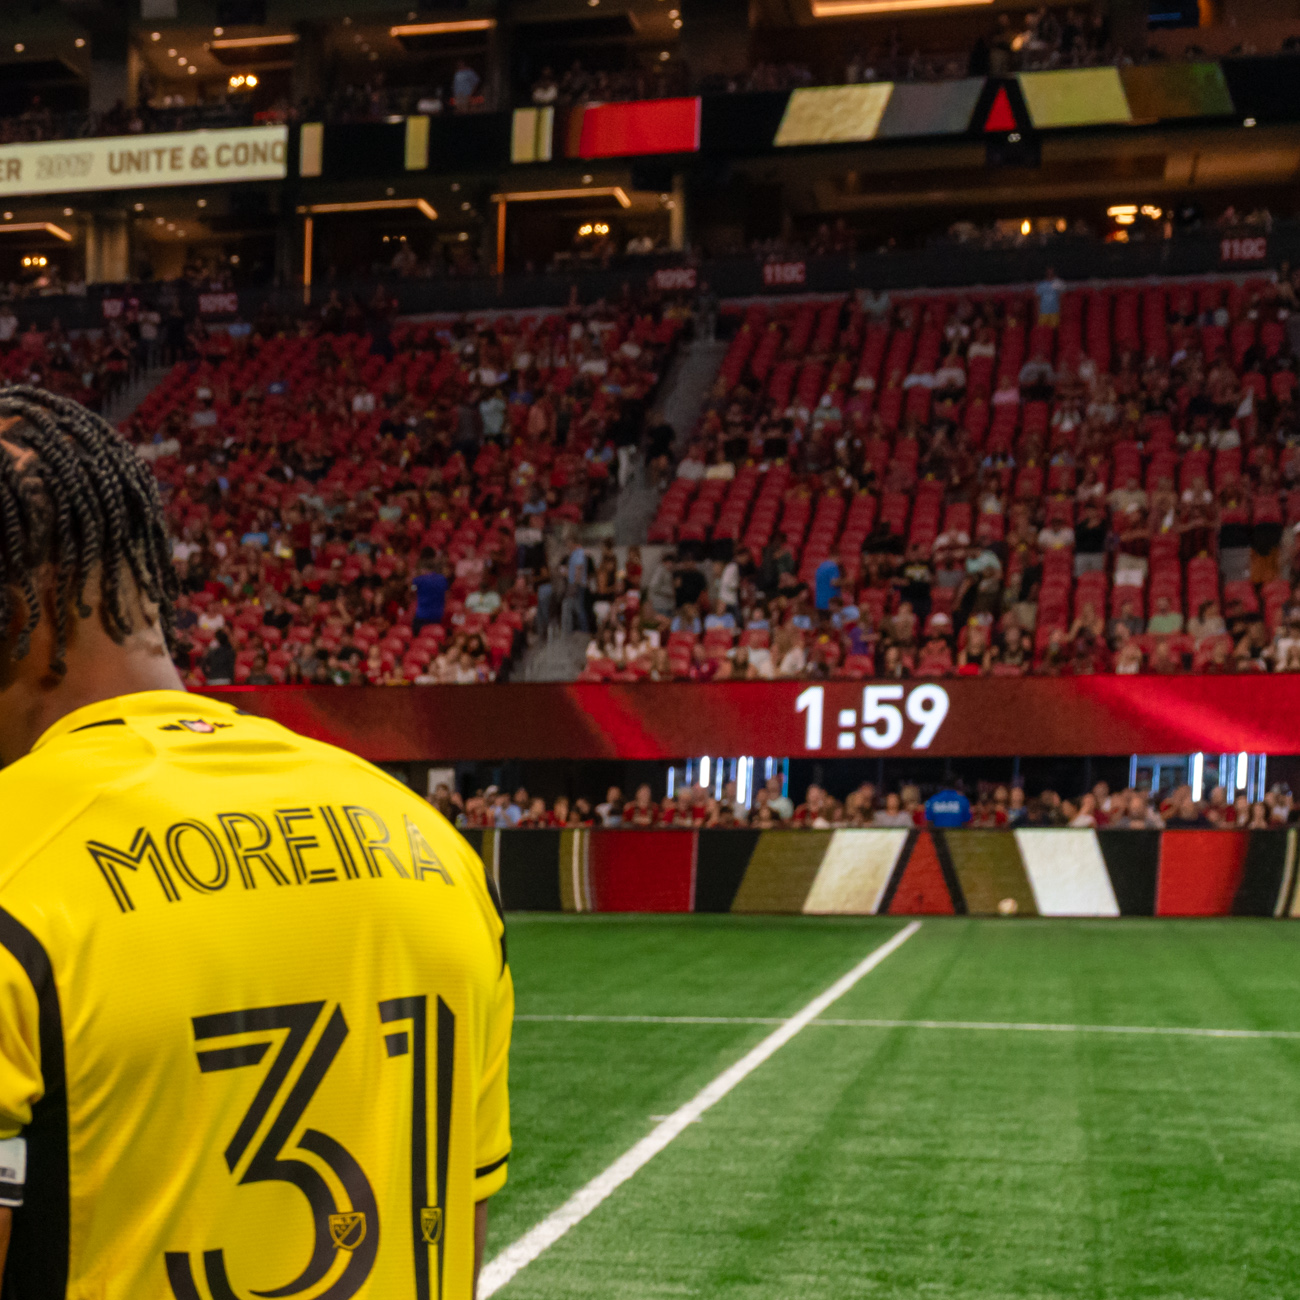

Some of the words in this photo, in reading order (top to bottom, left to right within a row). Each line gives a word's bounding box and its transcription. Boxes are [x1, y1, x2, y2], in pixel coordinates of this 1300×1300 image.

[108, 146, 184, 175] UNITE
[191, 146, 208, 170] &
[795, 683, 949, 750] 1:59
[86, 805, 456, 913] MOREIRA
